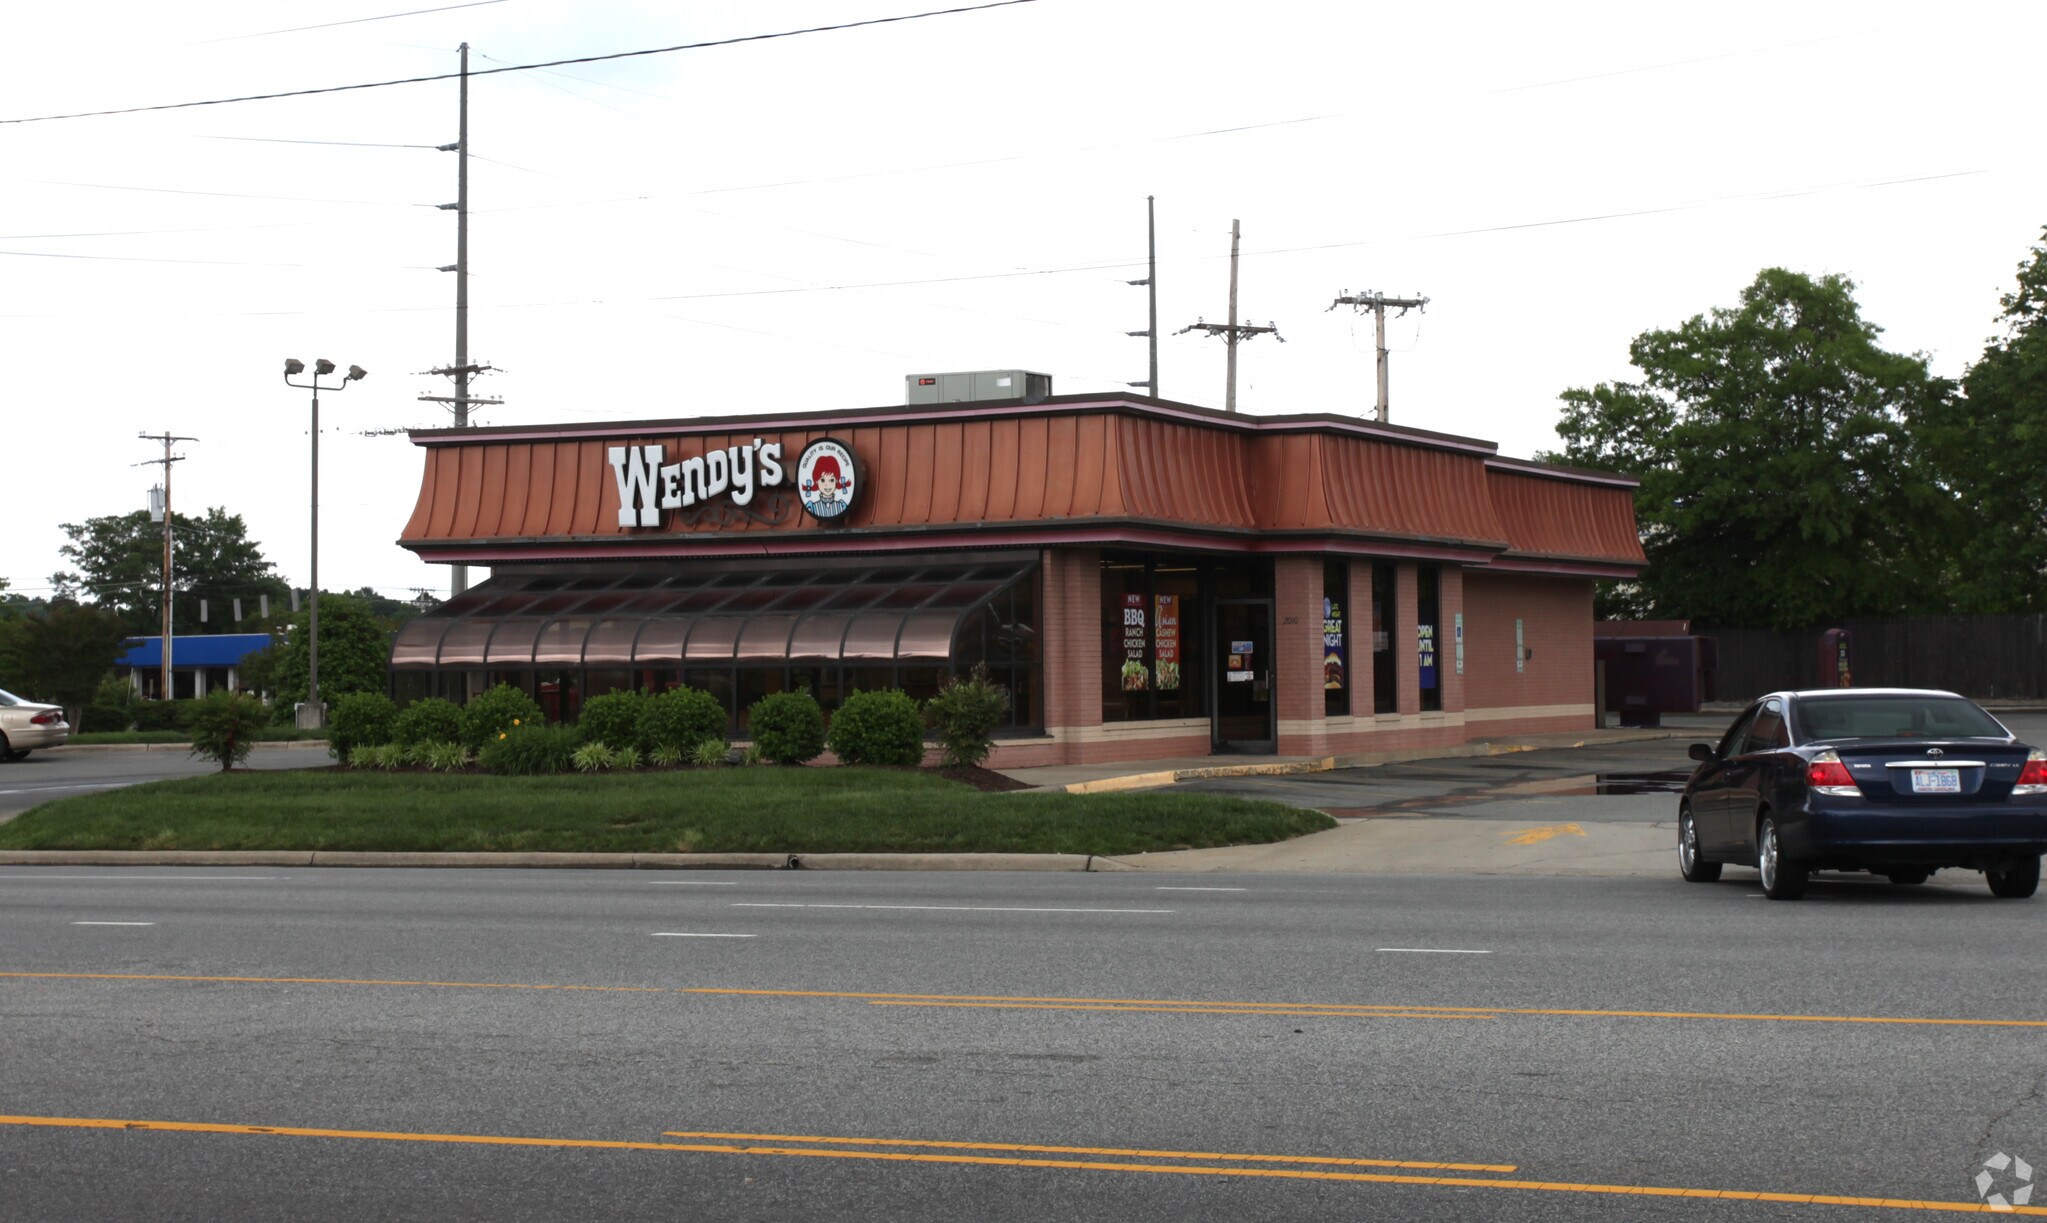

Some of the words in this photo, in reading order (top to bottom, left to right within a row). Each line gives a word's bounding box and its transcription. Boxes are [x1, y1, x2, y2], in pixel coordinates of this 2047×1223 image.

[802, 449, 817, 469] QUALITY
[836, 449, 850, 467] RECIPE
[608, 438, 783, 527] Wendy's
[1127, 595, 1141, 603] NEW
[1159, 595, 1172, 604] NEW
[1123, 608, 1145, 628] BBQ
[1154, 604, 1177, 629] Asian
[1323, 619, 1342, 633] GREAT
[1125, 627, 1144, 637] RANCH
[1155, 628, 1176, 638] CASHEW
[1123, 638, 1146, 648] CHICKEN
[1155, 639, 1177, 648] CHICKEN
[1324, 633, 1342, 647] NIGHT
[1127, 649, 1143, 658] SALAD
[1159, 649, 1174, 658] SALAD
[1423, 653, 1433, 667] AM
